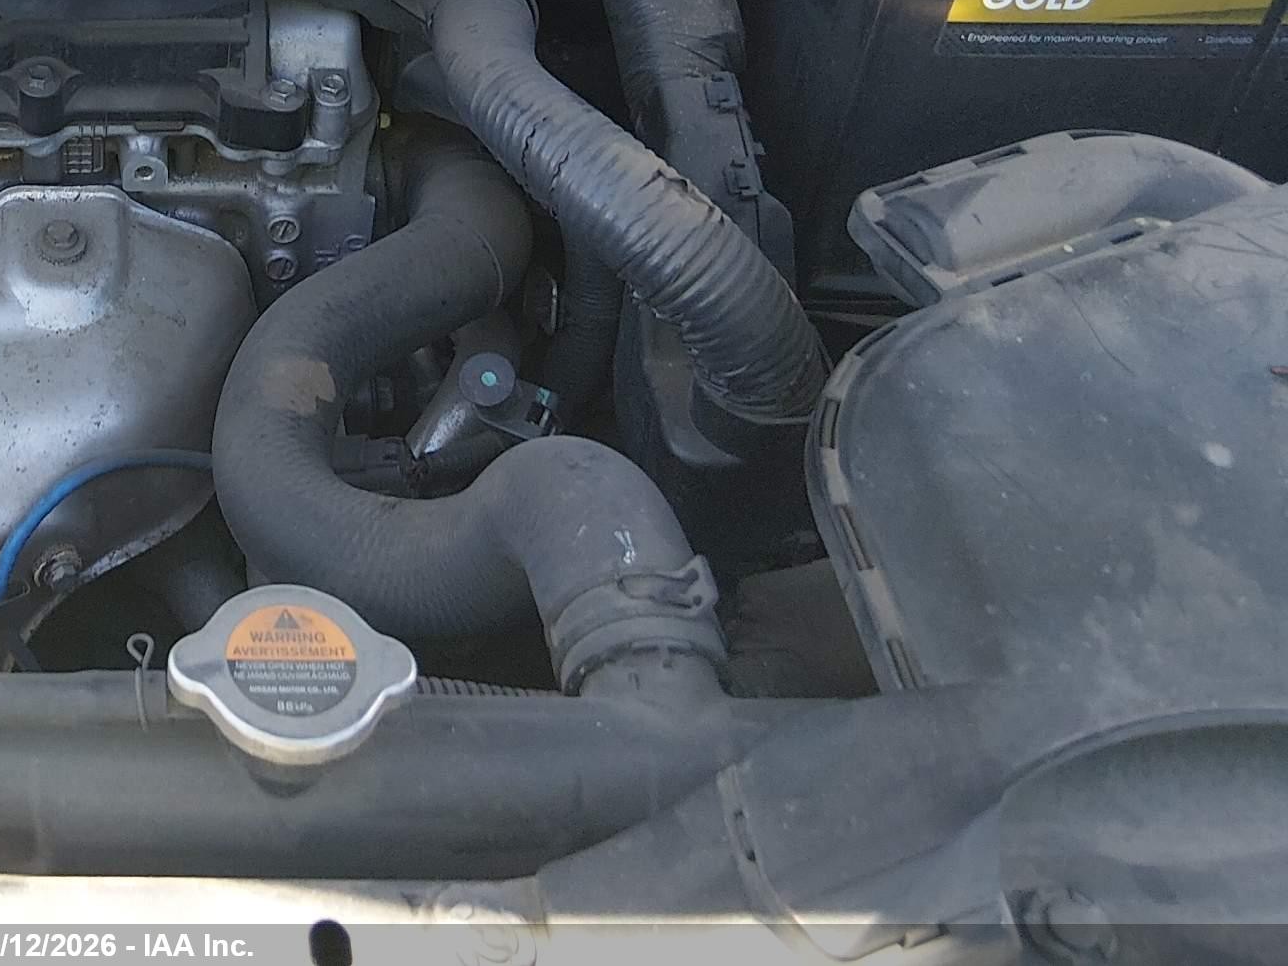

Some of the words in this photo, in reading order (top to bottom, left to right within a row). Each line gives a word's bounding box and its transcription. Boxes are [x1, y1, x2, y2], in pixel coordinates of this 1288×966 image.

[967, 33, 1025, 44] Engineered
[1028, 34, 1042, 43] for
[1044, 34, 1094, 43] maximum
[1135, 35, 1168, 44] power
[249, 631, 326, 643] WARNING
[233, 646, 346, 656] AVERTISSEMENT
[236, 662, 266, 670] NEVER
[267, 662, 294, 670] OPEN
[295, 662, 324, 670] WHEN
[326, 662, 345, 670] HOT
[249, 685, 277, 693] NISSAN
[278, 685, 306, 693] MOTOR
